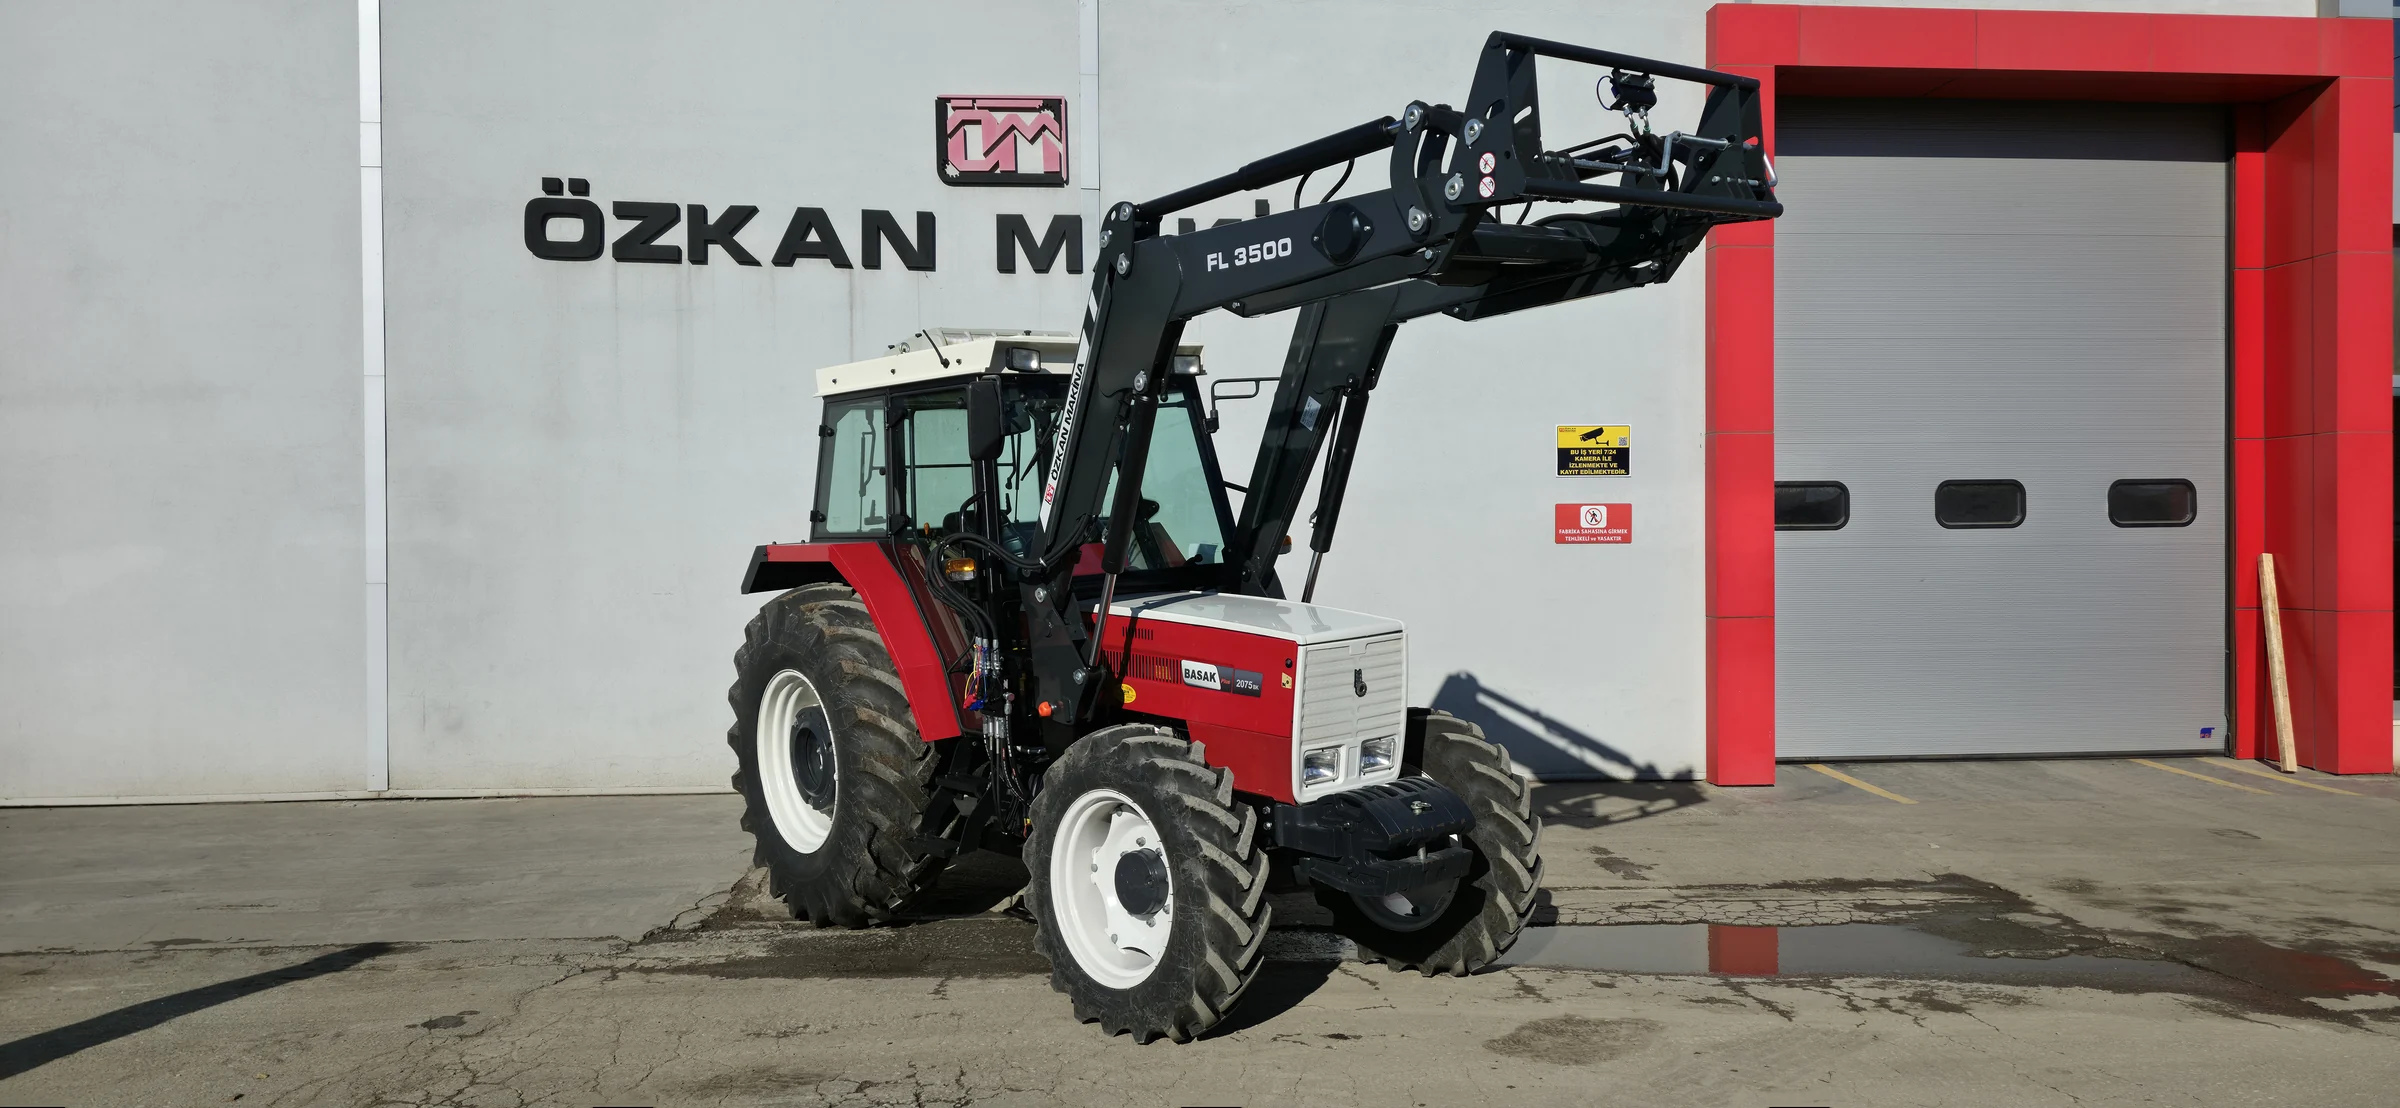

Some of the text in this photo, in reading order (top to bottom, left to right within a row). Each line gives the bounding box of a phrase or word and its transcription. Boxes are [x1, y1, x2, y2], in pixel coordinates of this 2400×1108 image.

[524, 177, 937, 272] ÖZKAN
[1206, 237, 1292, 272] FL 3500
[1051, 363, 1085, 481] ÖZKAN MAKİNA
[1184, 668, 1217, 683] BASAK
[1236, 679, 1253, 690] 2075
